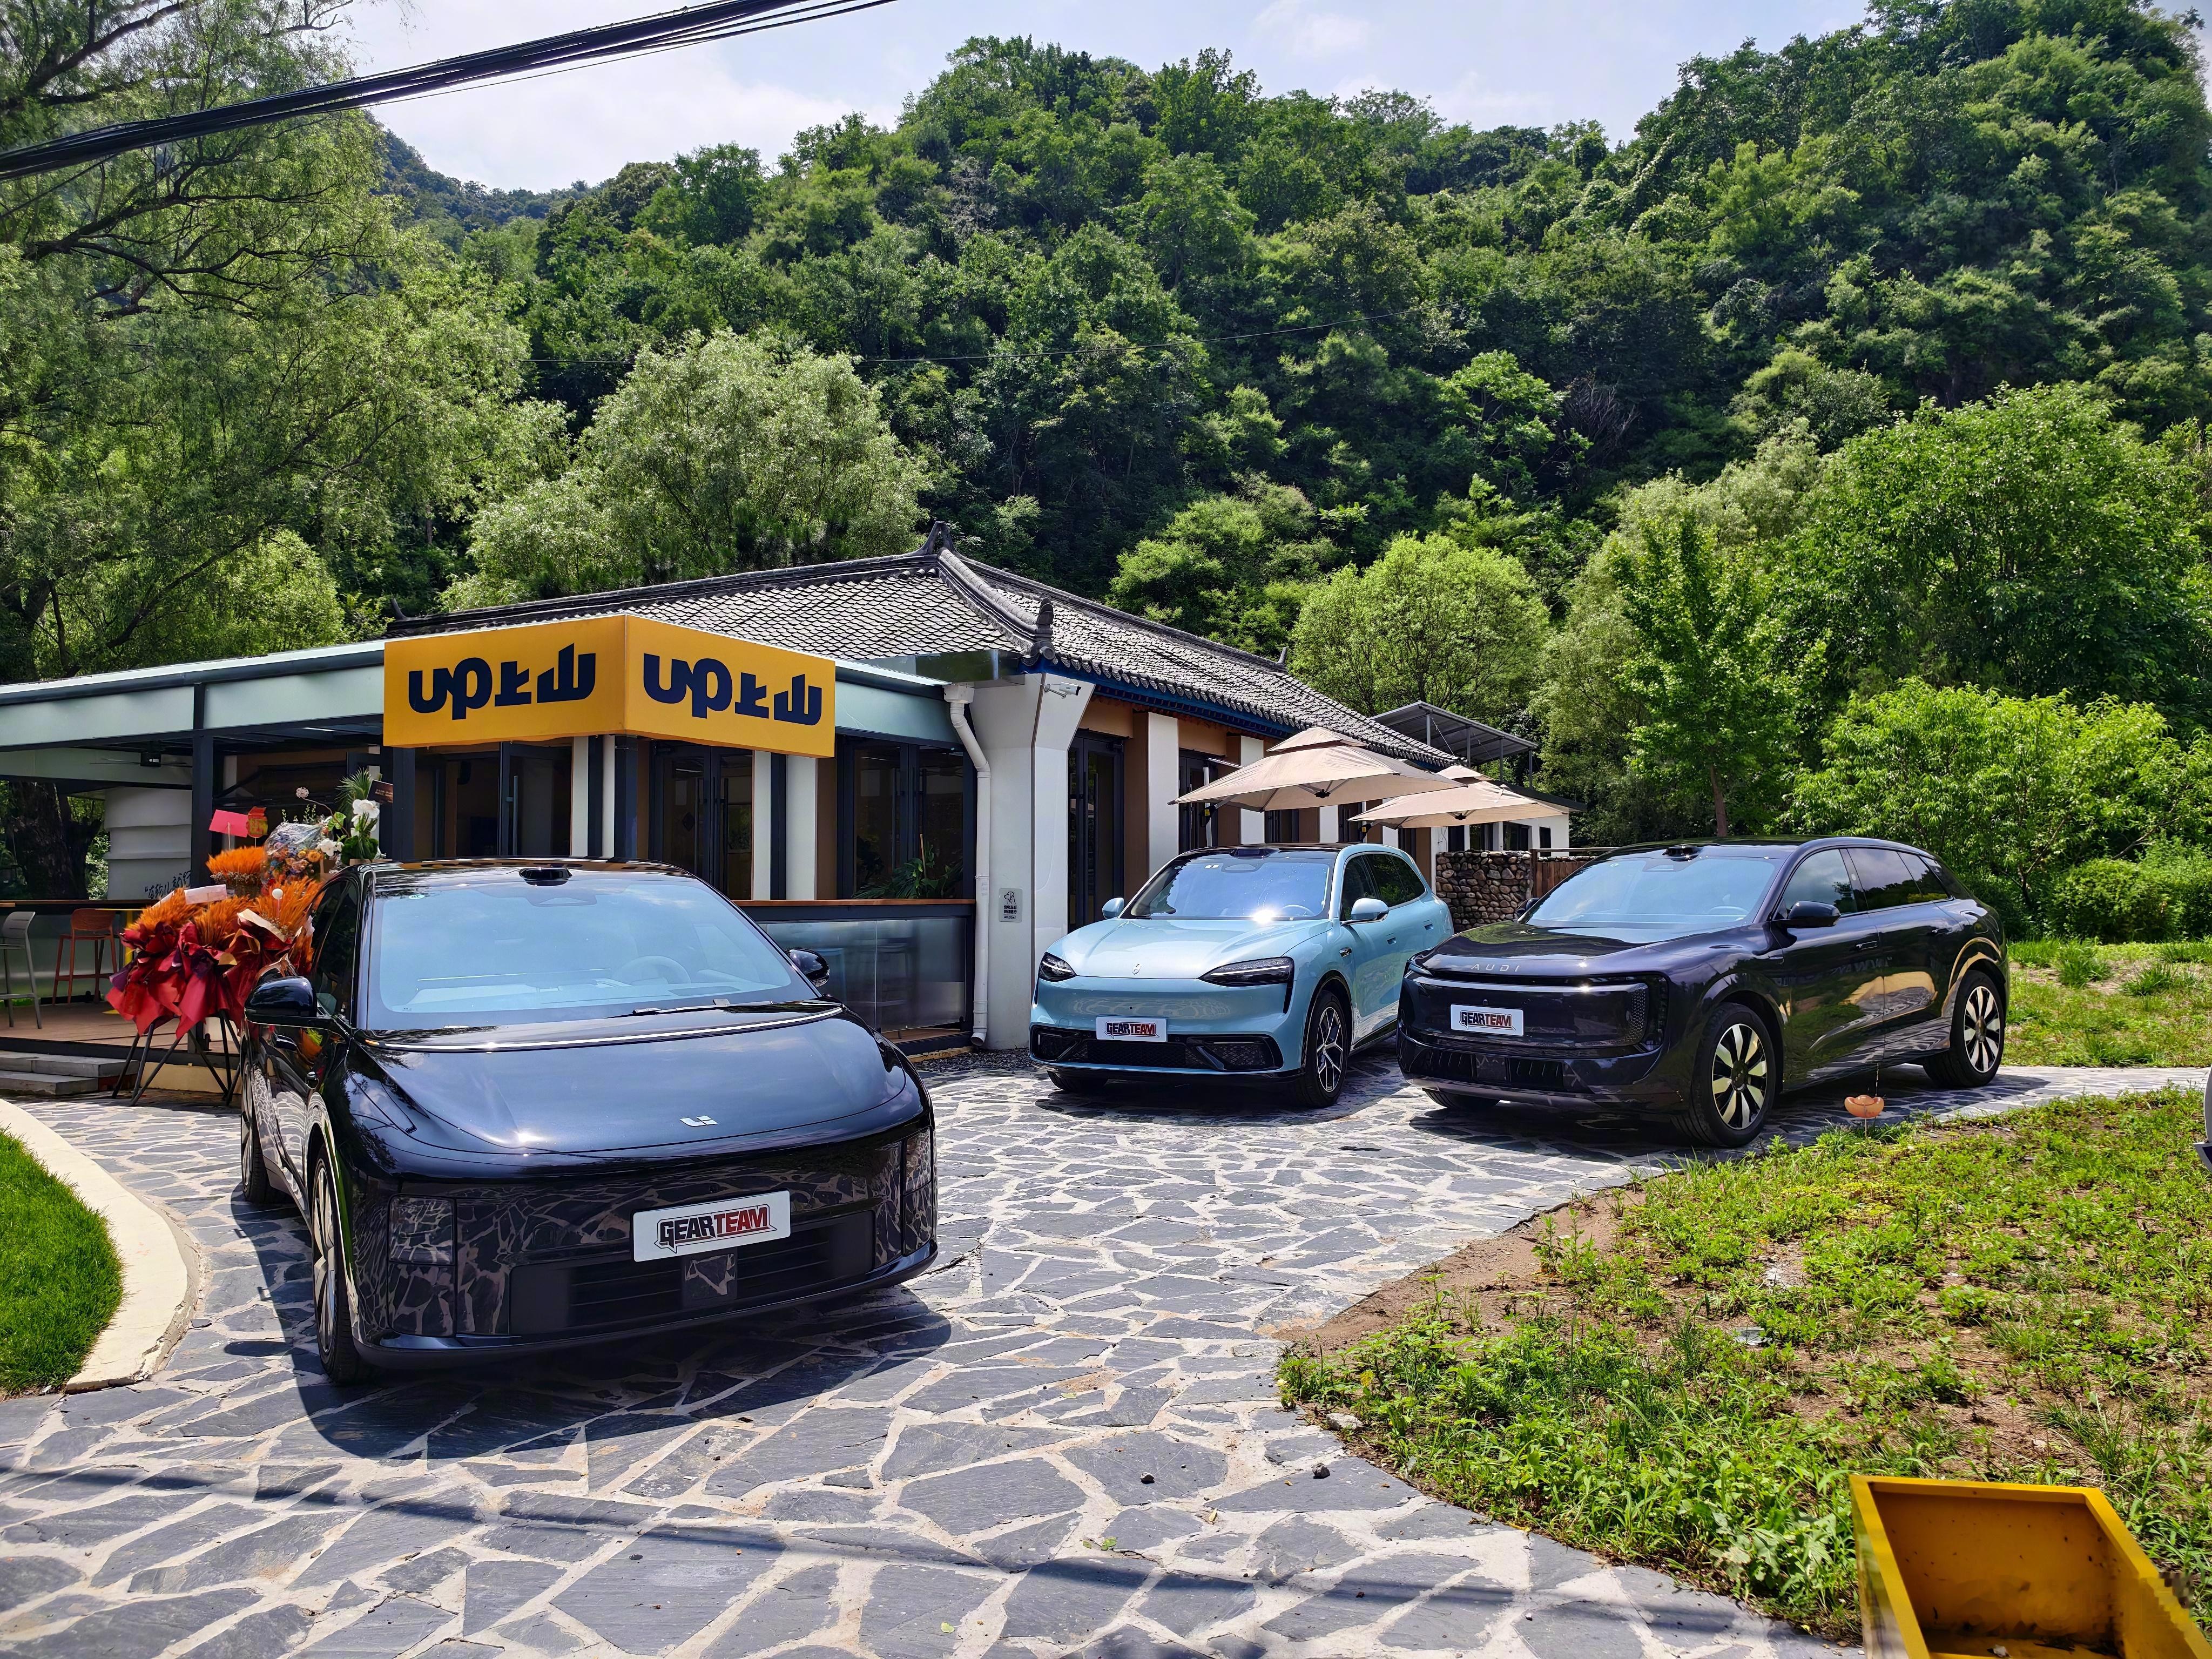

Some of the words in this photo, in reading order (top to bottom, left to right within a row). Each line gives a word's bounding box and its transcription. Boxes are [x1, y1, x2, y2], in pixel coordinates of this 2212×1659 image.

[1471, 963, 1520, 972] AUDI
[1461, 1011, 1512, 1028] GEARTEAM
[1106, 1022, 1156, 1037] GEARTEAM
[659, 1206, 768, 1249] GEARTEAM
